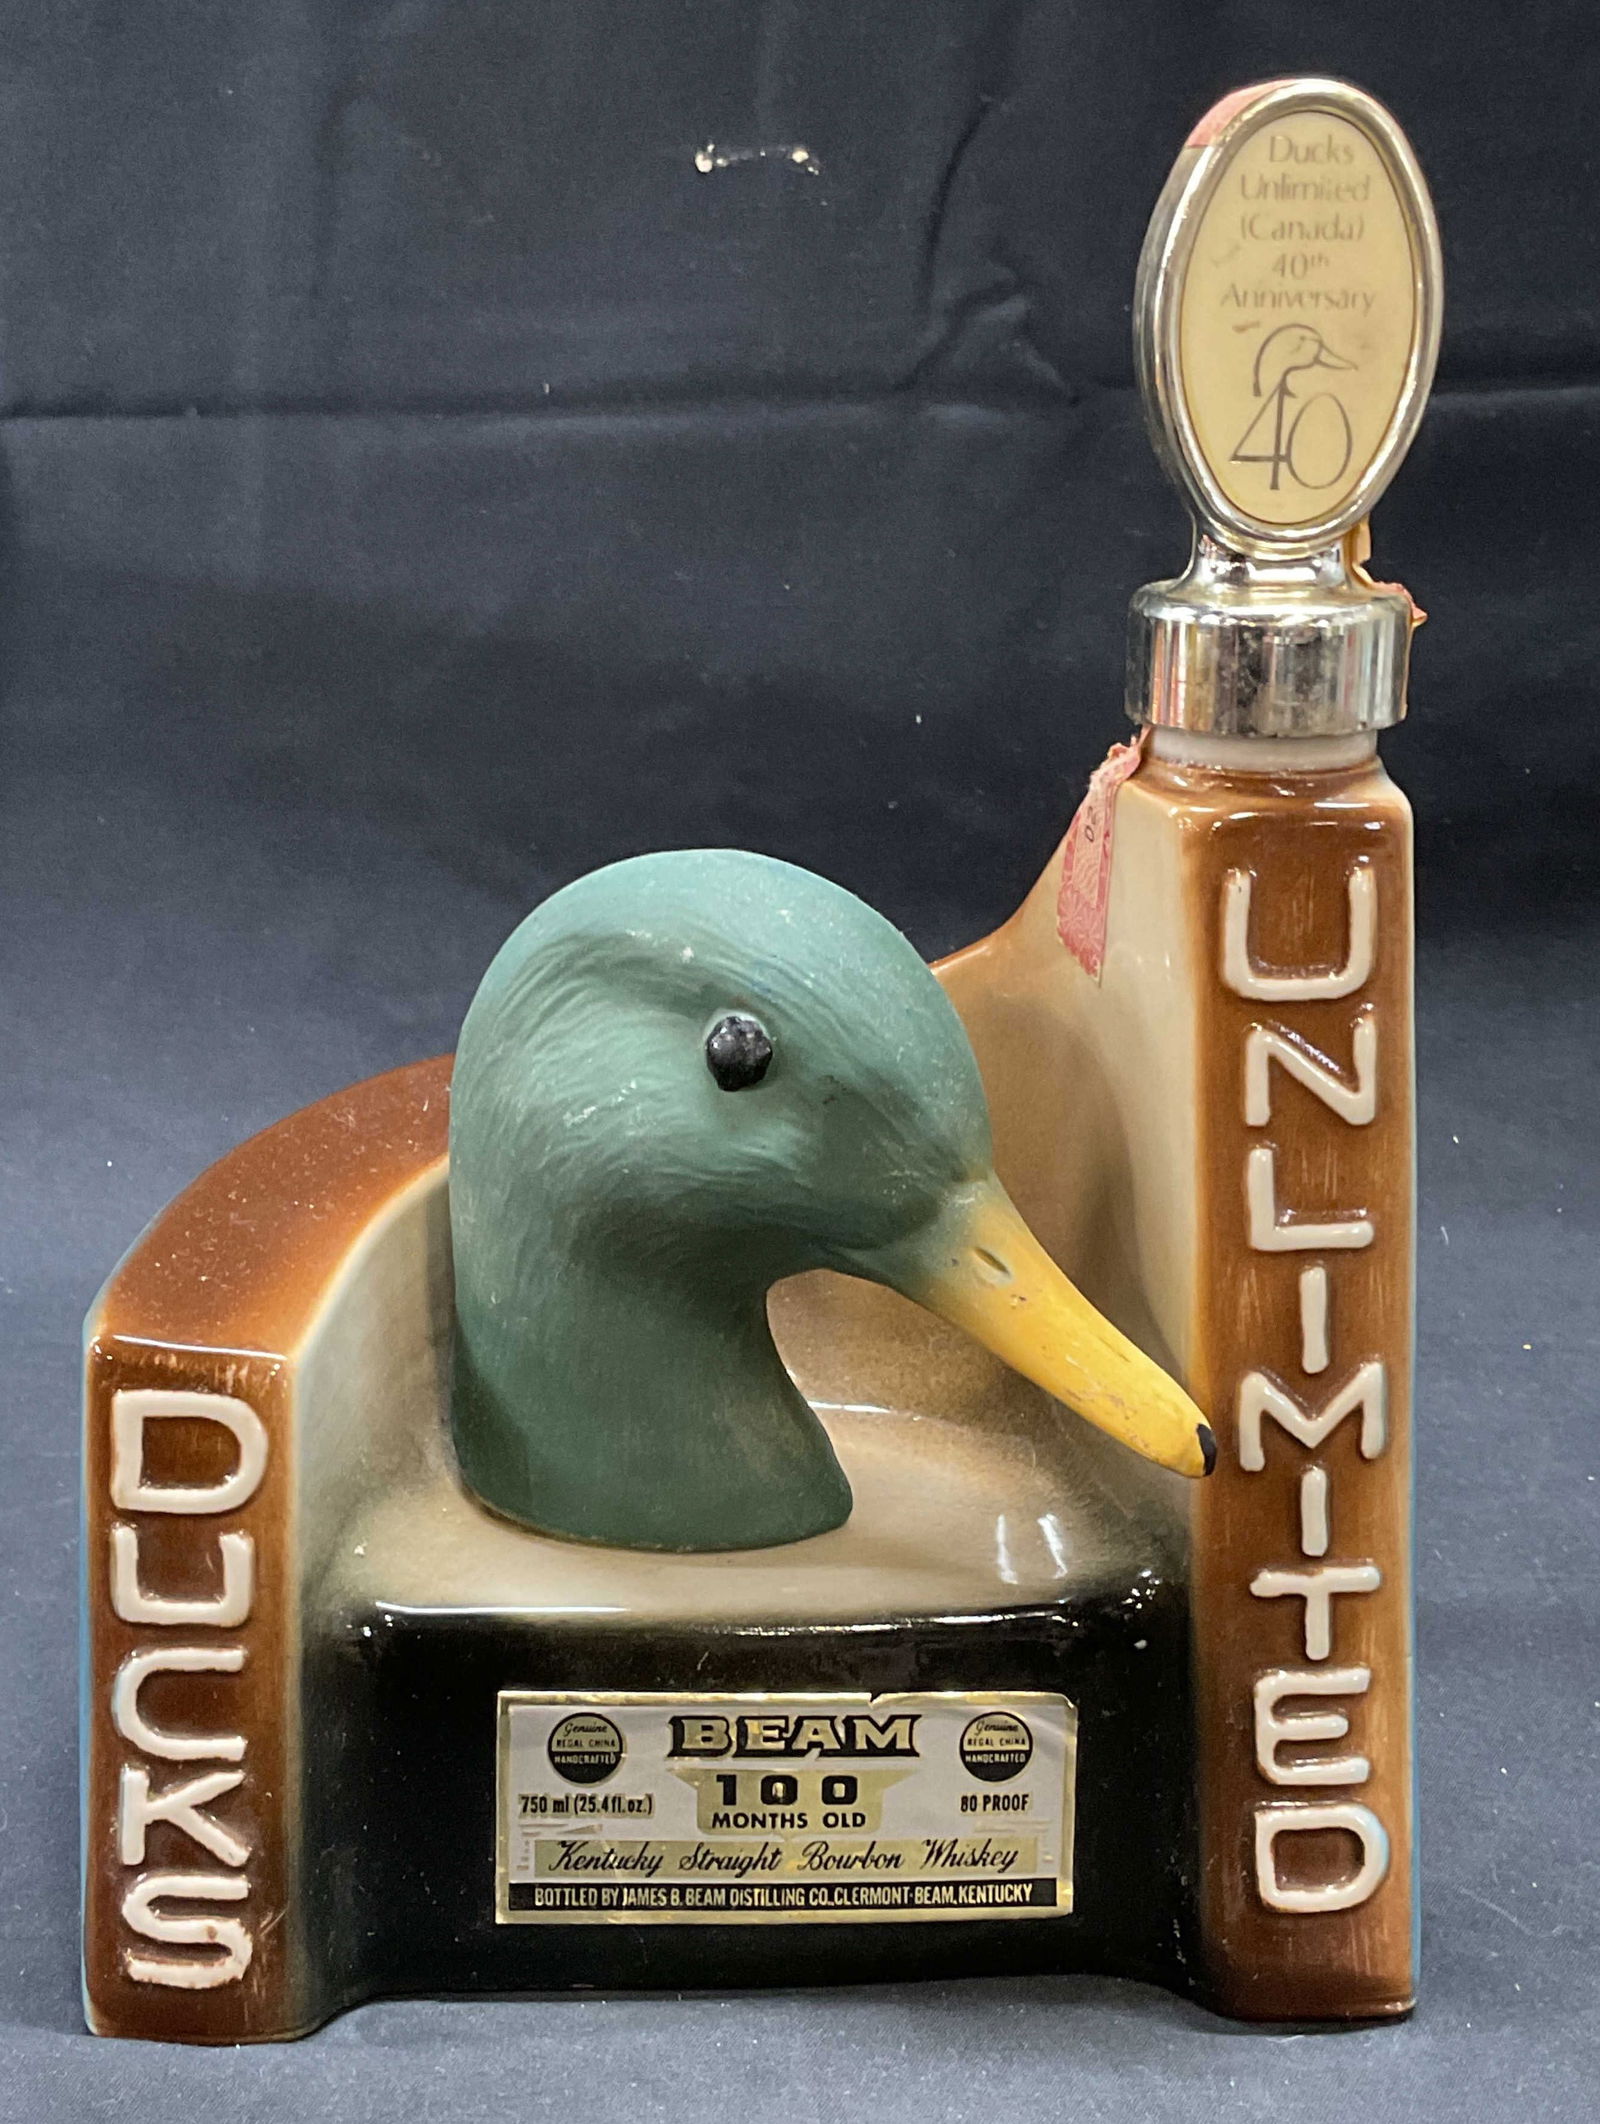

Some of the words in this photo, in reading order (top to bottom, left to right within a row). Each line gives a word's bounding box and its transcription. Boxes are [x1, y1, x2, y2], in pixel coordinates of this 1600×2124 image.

[1269, 134, 1354, 165] Ducks
[1240, 172, 1371, 202] Unlimited
[1240, 213, 1366, 242] (Canada)
[1271, 252, 1330, 281] 40th
[1219, 283, 1377, 317] Anniversary
[1229, 384, 1353, 491] 40
[1223, 866, 1389, 1914] UNLIMITED
[110, 1389, 269, 1989] DUCKS
[563, 1721, 608, 1737] Genuine
[667, 1714, 922, 1759] BEAM
[975, 1720, 1019, 1736] Genuine
[554, 1752, 616, 1765] HANDCRAFTED
[965, 1753, 1026, 1764] HANDCRAFTED
[521, 1795, 548, 1813] 750
[552, 1795, 569, 1813] ml
[961, 1795, 978, 1812] 80
[982, 1794, 1029, 1811] PROOF
[711, 1812, 808, 1829] MONTHS
[822, 1812, 866, 1828] OLD
[548, 1840, 664, 1878] Kentucky
[678, 1841, 783, 1879] Straight
[796, 1840, 904, 1871] Bourbon
[920, 1837, 1019, 1874] Whiskey
[534, 1887, 598, 1907] BOTTLED
[601, 1887, 619, 1906] BY
[621, 1887, 667, 1907] JAMES
[670, 1887, 683, 1907] B.
[685, 1887, 726, 1907] BEAM
[729, 1887, 805, 1907] DISTILLING
[958, 1883, 1033, 1904] KENTUCKY
